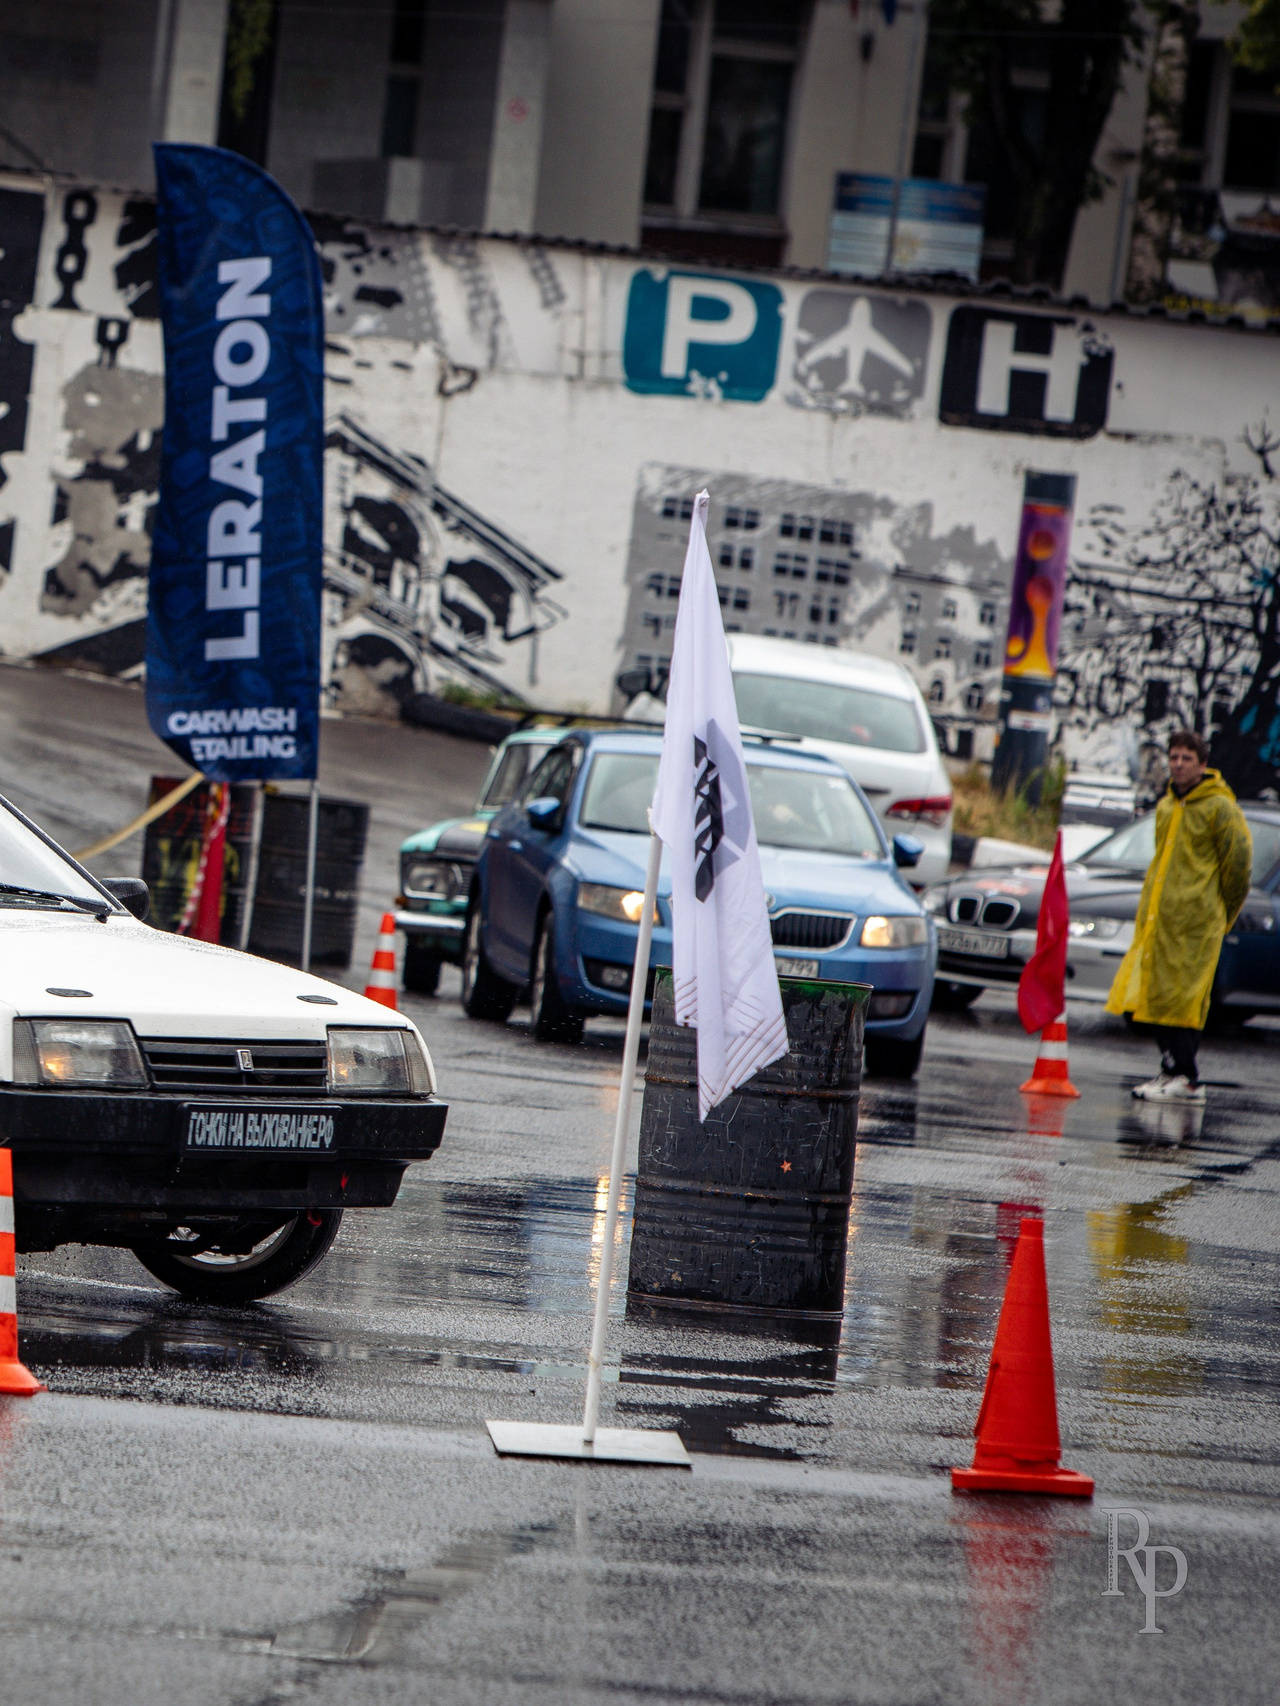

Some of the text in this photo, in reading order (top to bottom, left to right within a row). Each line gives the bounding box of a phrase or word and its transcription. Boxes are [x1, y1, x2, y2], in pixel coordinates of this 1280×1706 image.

[660, 276, 758, 379] P
[976, 319, 1086, 423] H
[205, 256, 272, 661] LERATON
[167, 707, 297, 735] CARWASH
[187, 1111, 228, 1146] ГОНКИ
[227, 1112, 244, 1147] НА
